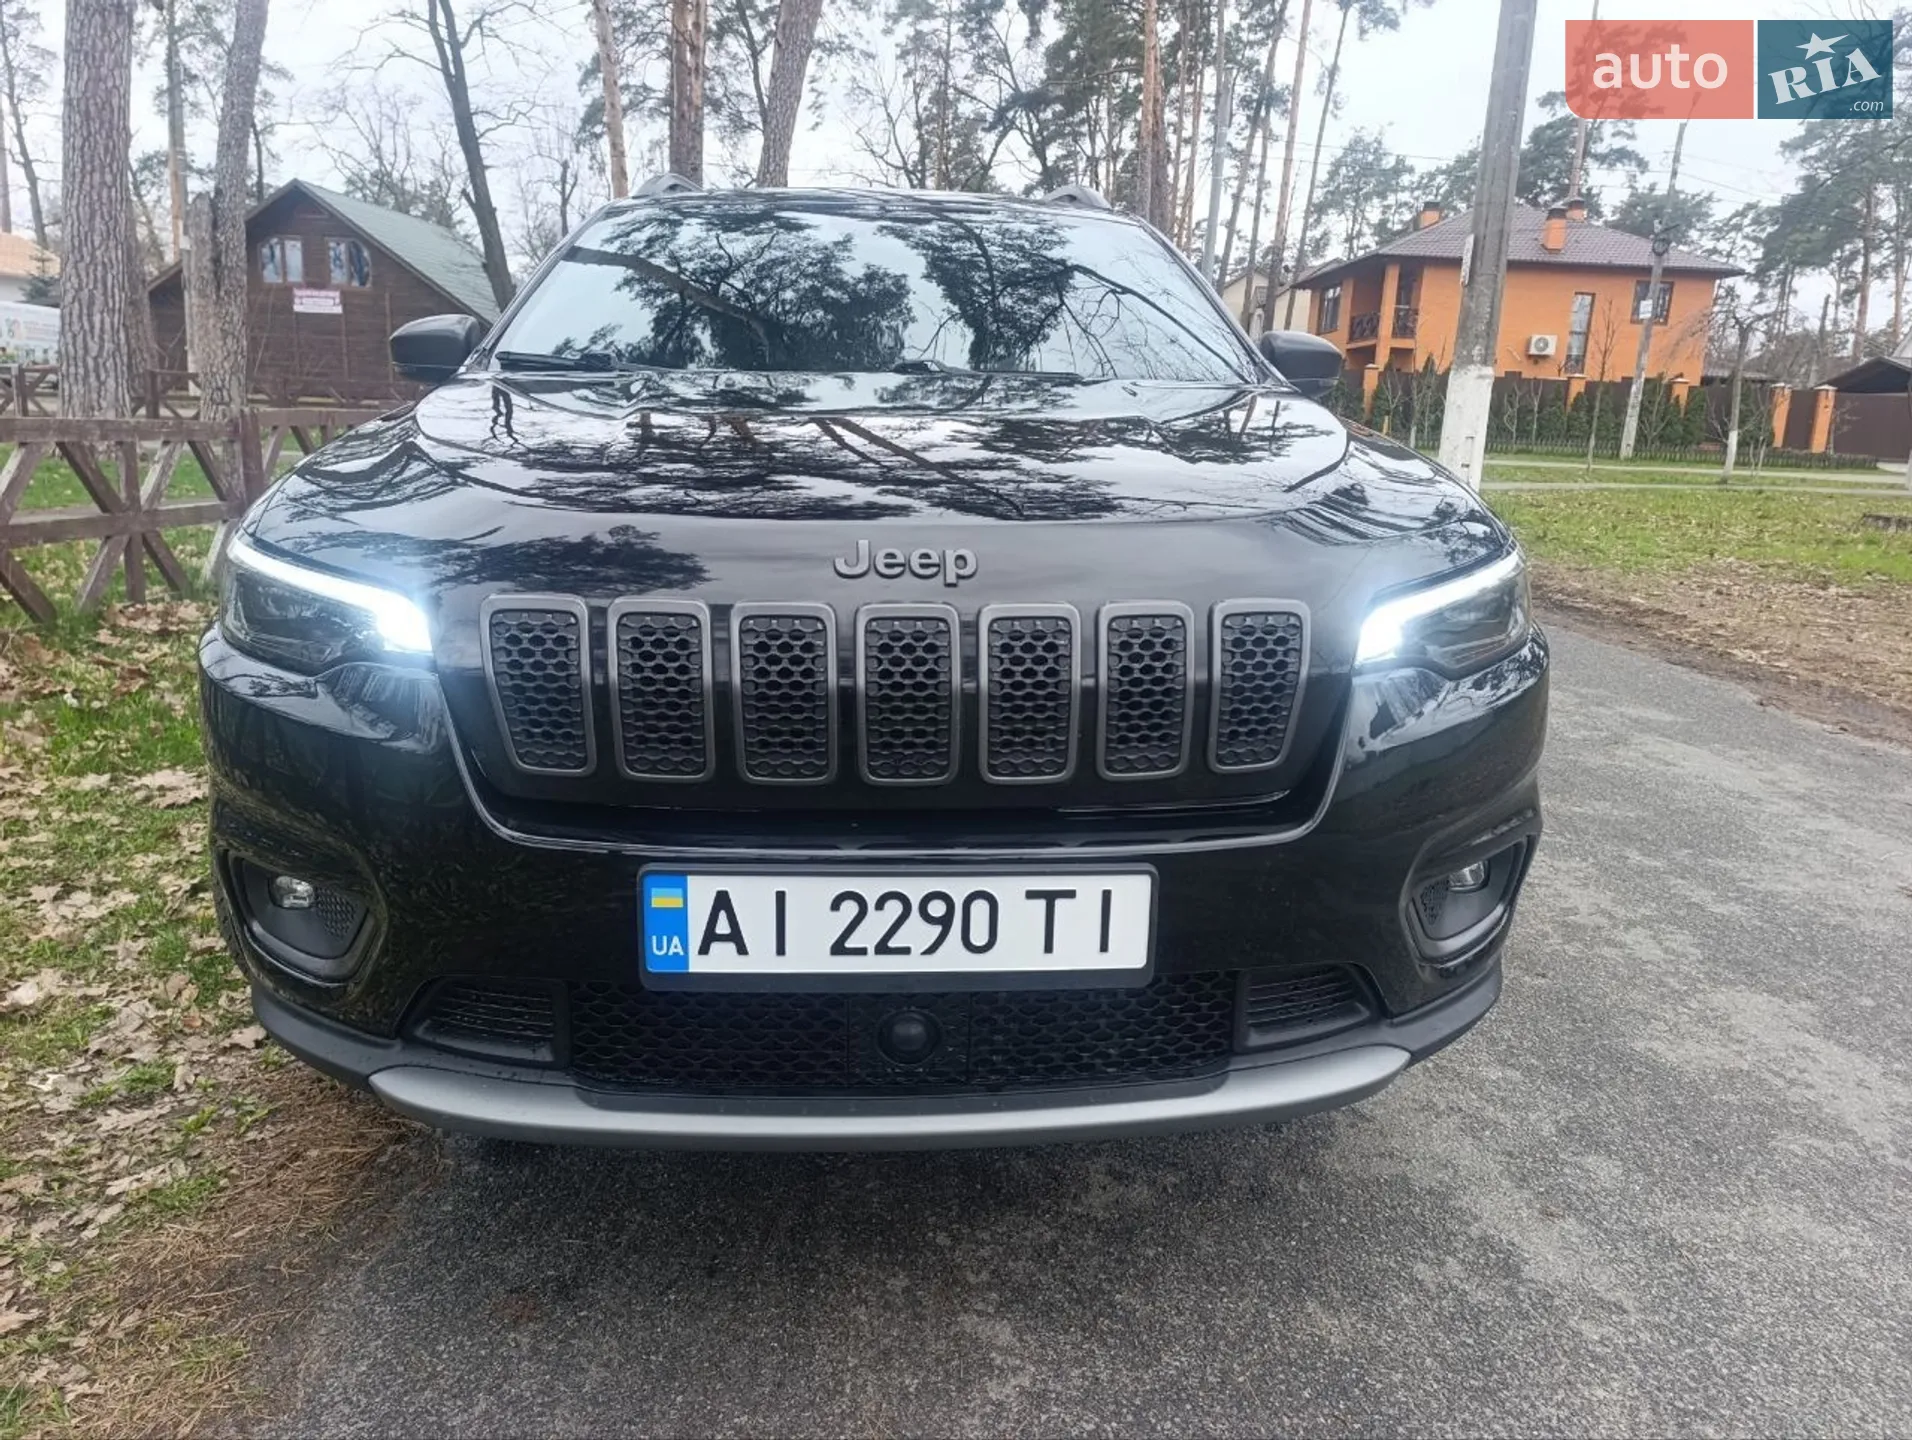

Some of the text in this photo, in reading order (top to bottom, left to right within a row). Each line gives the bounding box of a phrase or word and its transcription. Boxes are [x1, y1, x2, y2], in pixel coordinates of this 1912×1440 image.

[834, 539, 978, 587] Jeep
[652, 935, 685, 957] UA
[697, 888, 1113, 957] AI 2290 TI
